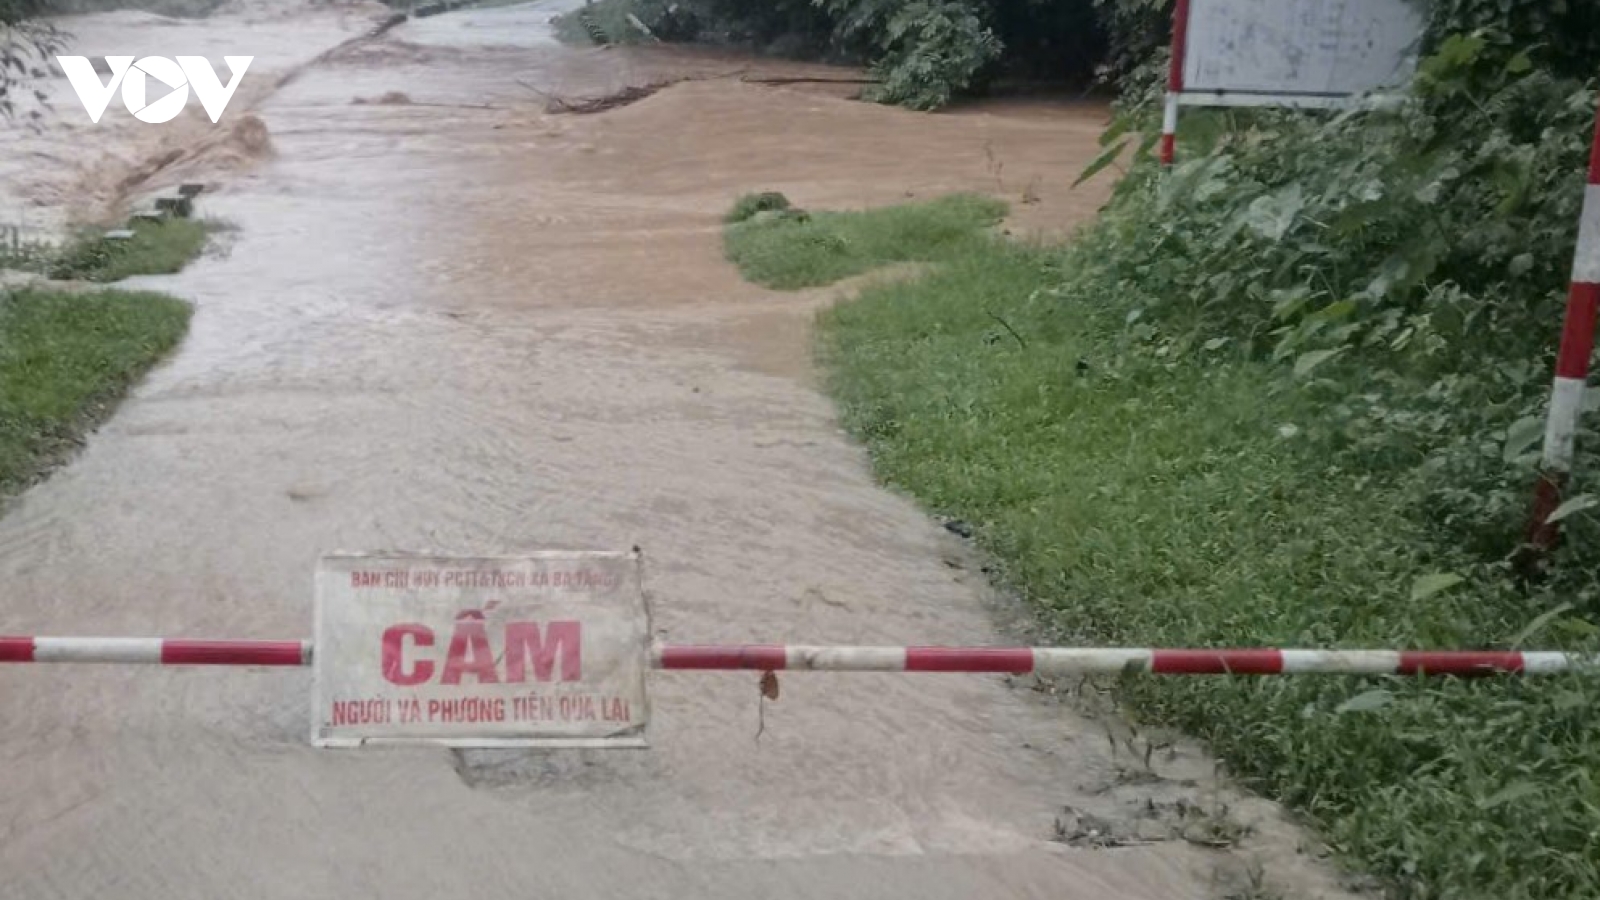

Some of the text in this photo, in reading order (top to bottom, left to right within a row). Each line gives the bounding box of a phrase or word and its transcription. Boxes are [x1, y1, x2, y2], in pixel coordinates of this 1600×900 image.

[350, 571, 381, 587] BAN
[381, 600, 581, 686] CẤM
[333, 691, 630, 726] NGƯỜI VÀ PHƯƠNG TIỆN QUA LẠI
